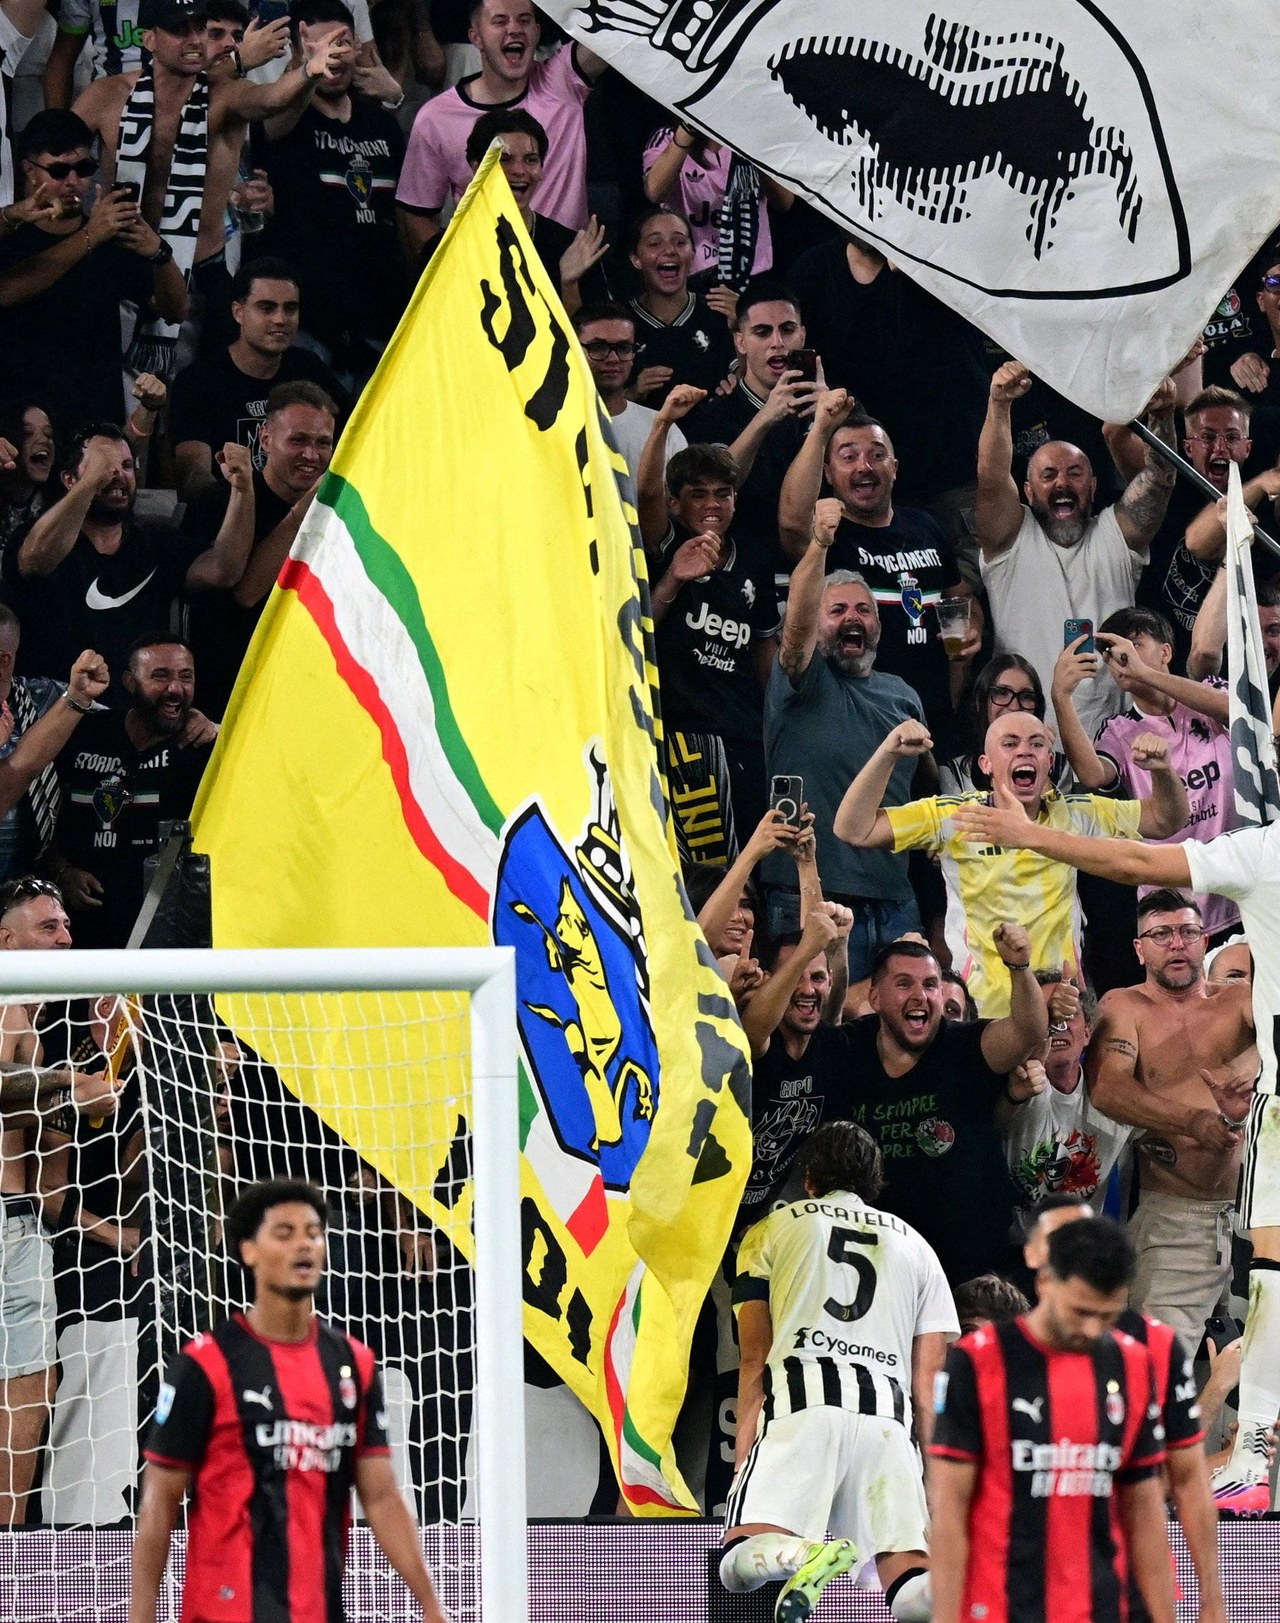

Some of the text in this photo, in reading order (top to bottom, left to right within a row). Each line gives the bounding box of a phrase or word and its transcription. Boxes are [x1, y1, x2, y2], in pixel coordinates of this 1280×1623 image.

[355, 209, 377, 224] NOI
[685, 601, 751, 650] Jeep
[907, 627, 927, 645] NOI
[704, 641, 729, 657] VISIT
[94, 831, 117, 848] NOI
[873, 1093, 939, 1121] SEMPRE
[880, 1123, 915, 1140] PER
[791, 1202, 907, 1237] LOCATELLI
[823, 1225, 878, 1323] 5
[812, 1330, 898, 1367] Cygames
